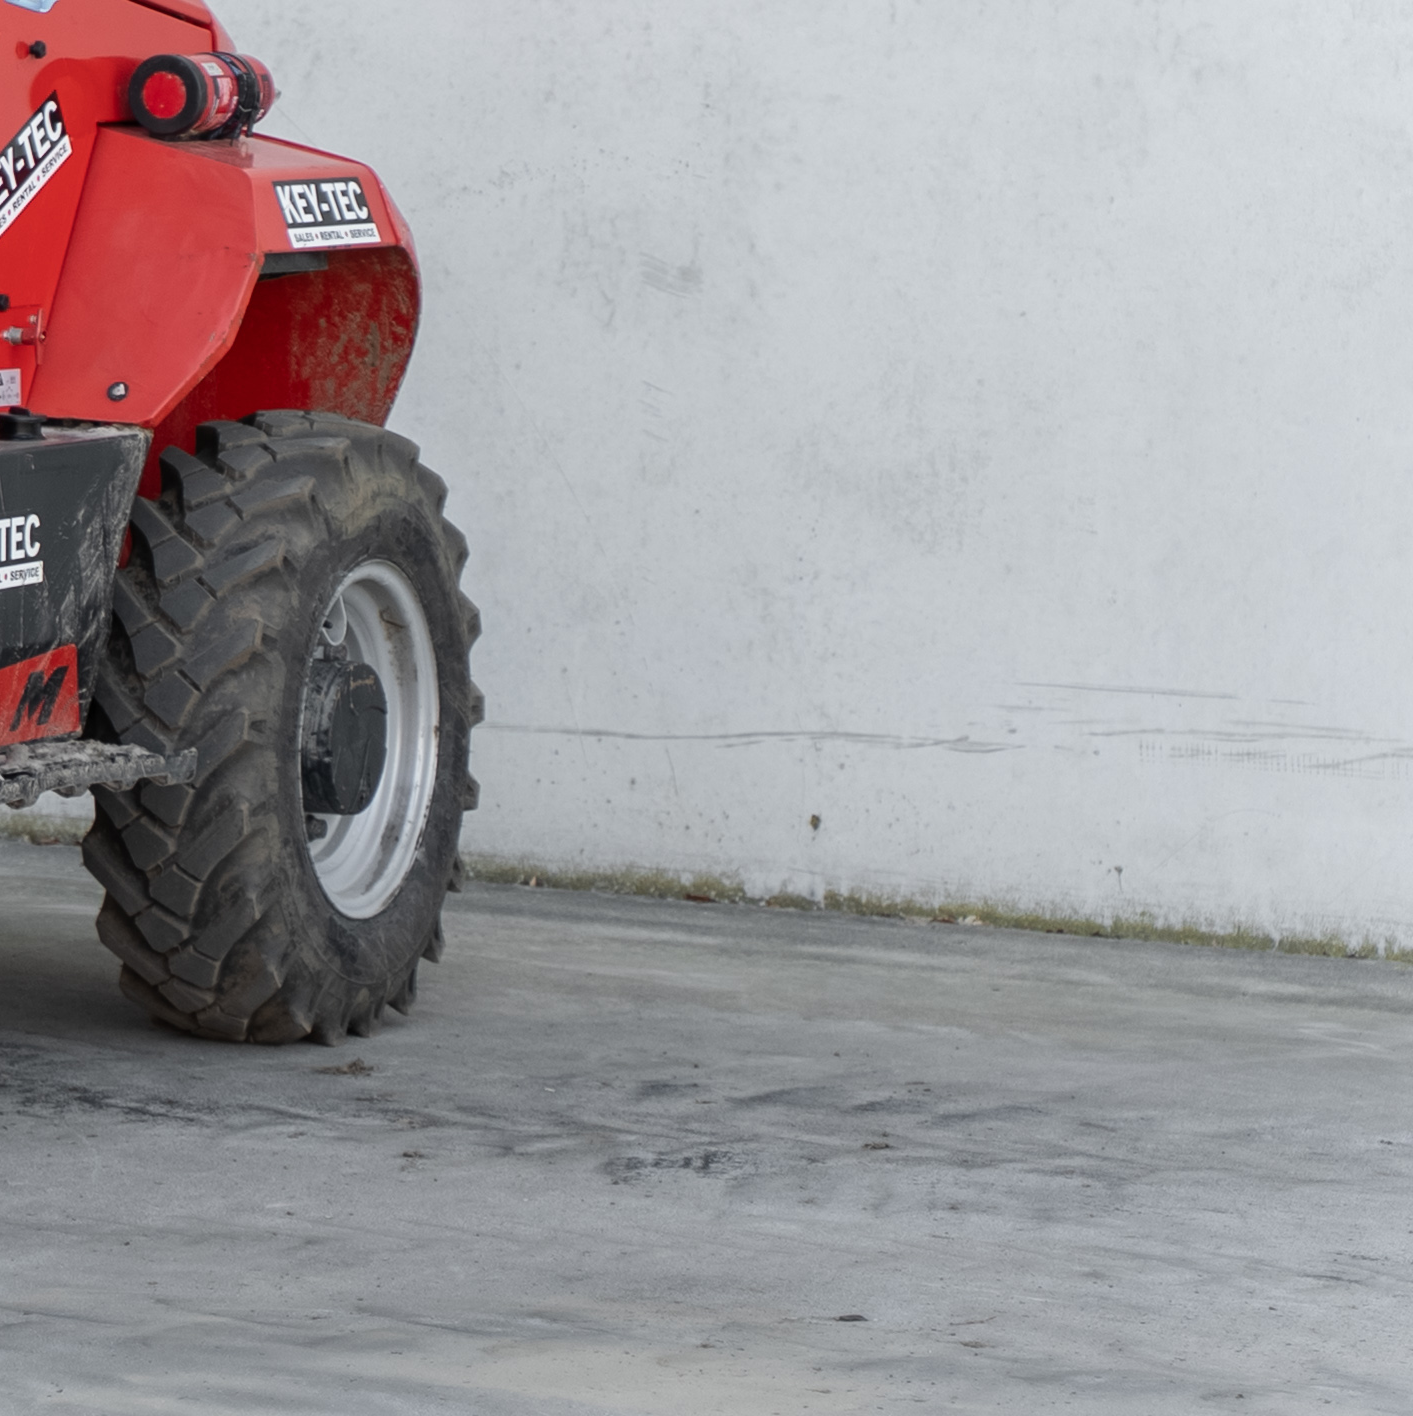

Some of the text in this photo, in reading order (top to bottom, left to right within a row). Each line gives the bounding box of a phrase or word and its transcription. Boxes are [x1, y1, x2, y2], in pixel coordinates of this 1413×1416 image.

[12, 182, 37, 212] RENTAL
[41, 143, 69, 178] SERVICE
[275, 181, 369, 224] KEY-TEC
[294, 228, 377, 243] SALES RENTAL SERVICE
[9, 566, 40, 582] SERVICE
